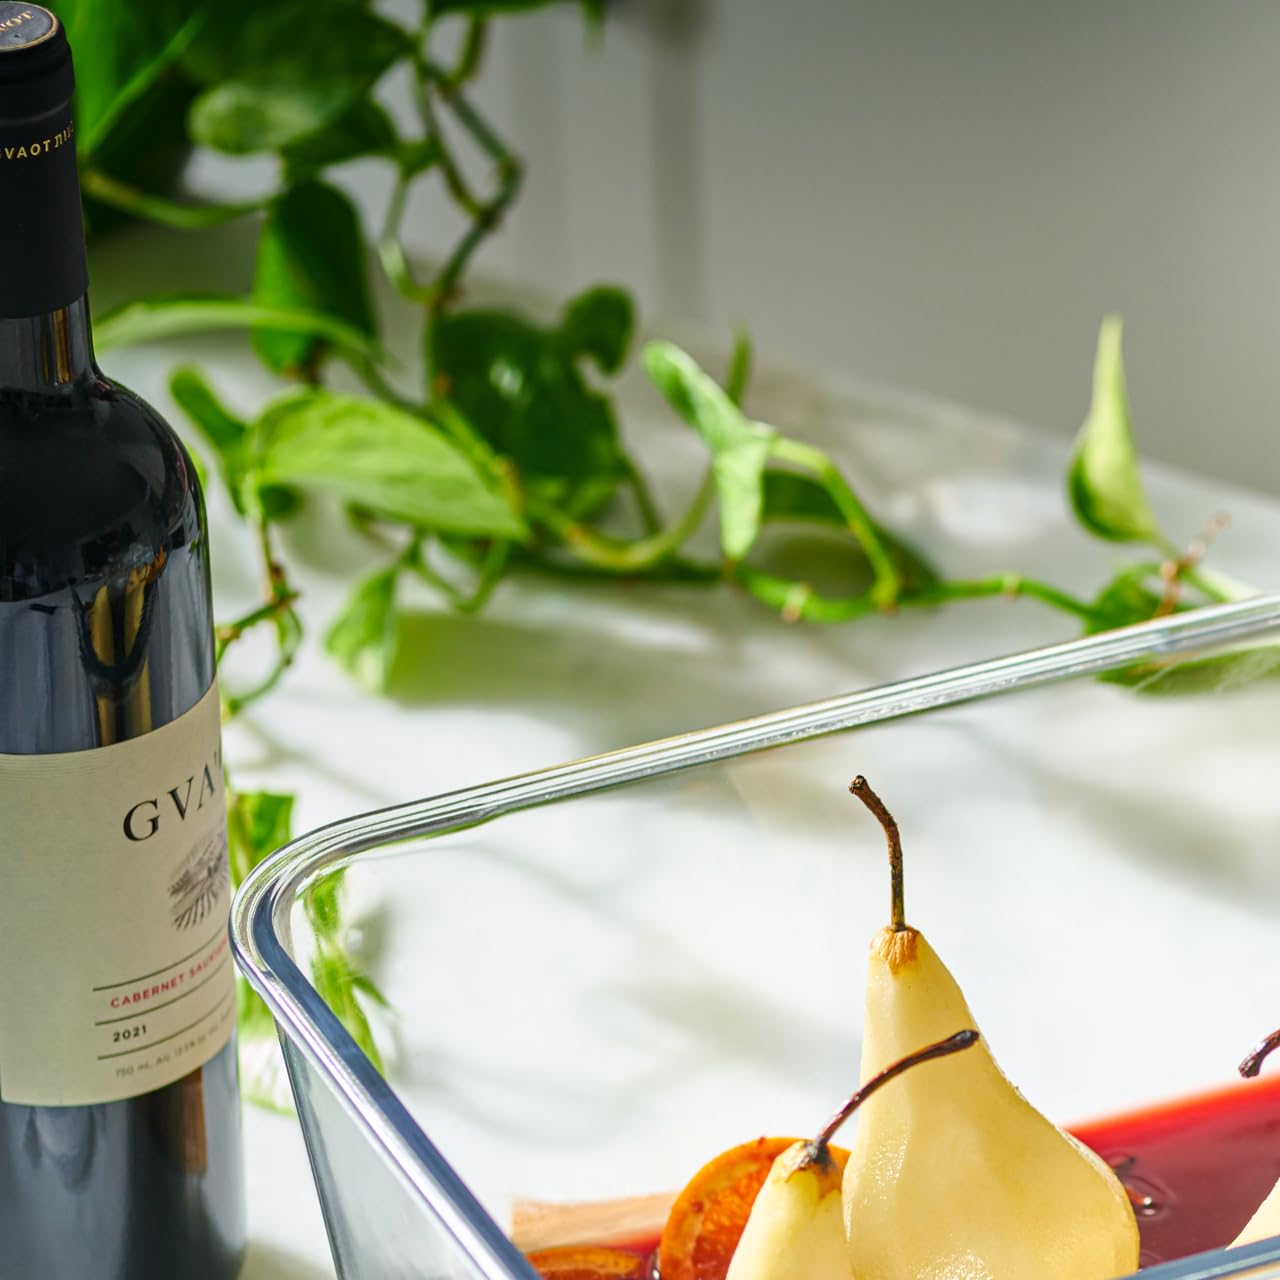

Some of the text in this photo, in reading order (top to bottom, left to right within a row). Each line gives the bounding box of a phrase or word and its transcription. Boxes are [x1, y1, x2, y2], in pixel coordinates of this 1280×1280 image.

[0, 139, 51, 160] VAOT
[122, 742, 222, 842] GVA'
[110, 973, 185, 1009] CABERNET
[113, 1024, 147, 1042] 2021
